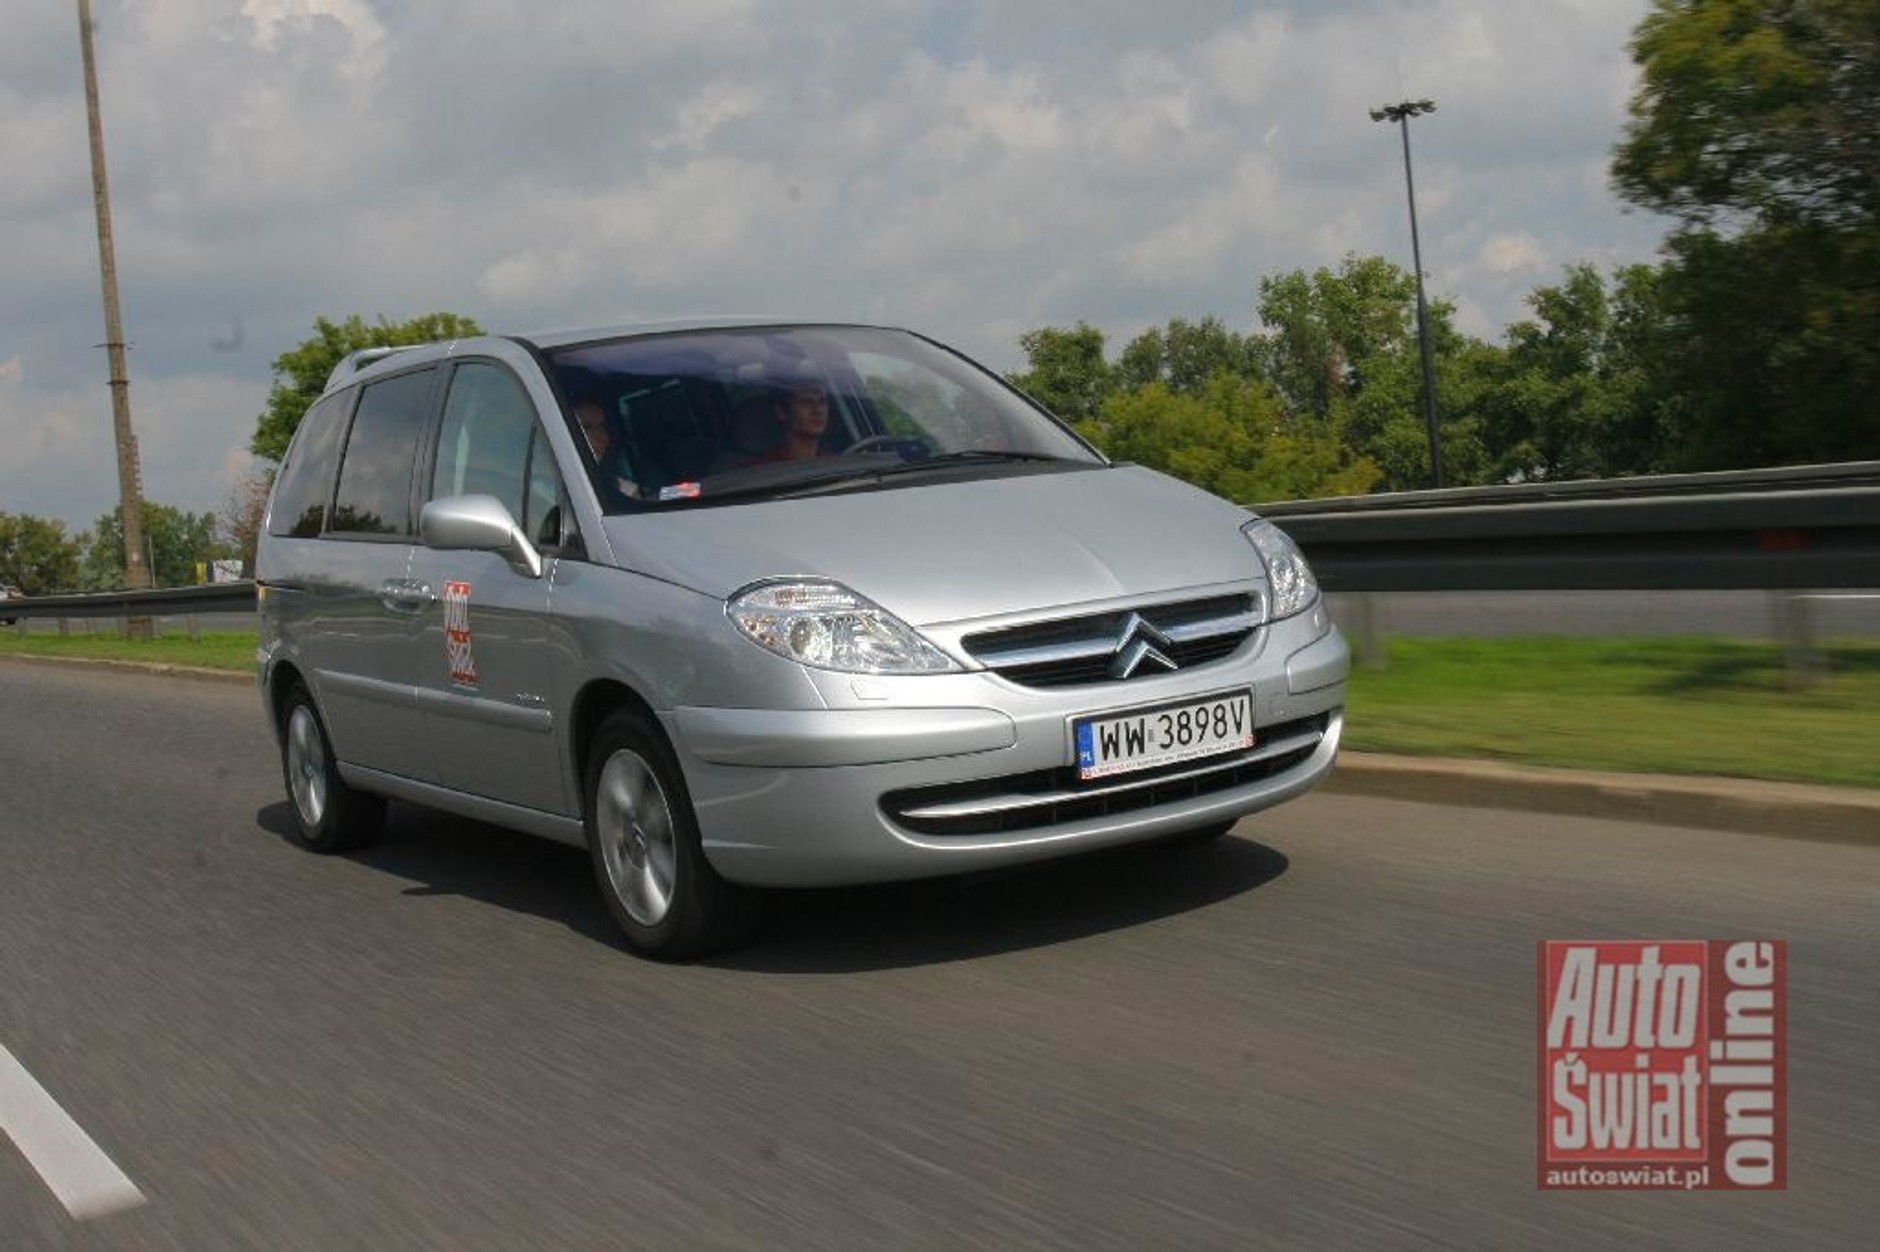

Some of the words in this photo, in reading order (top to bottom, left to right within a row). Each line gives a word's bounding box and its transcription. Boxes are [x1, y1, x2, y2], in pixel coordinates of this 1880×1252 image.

[1099, 717, 1145, 761] WW
[1157, 698, 1245, 750] 3898V
[1080, 750, 1092, 762] PL
